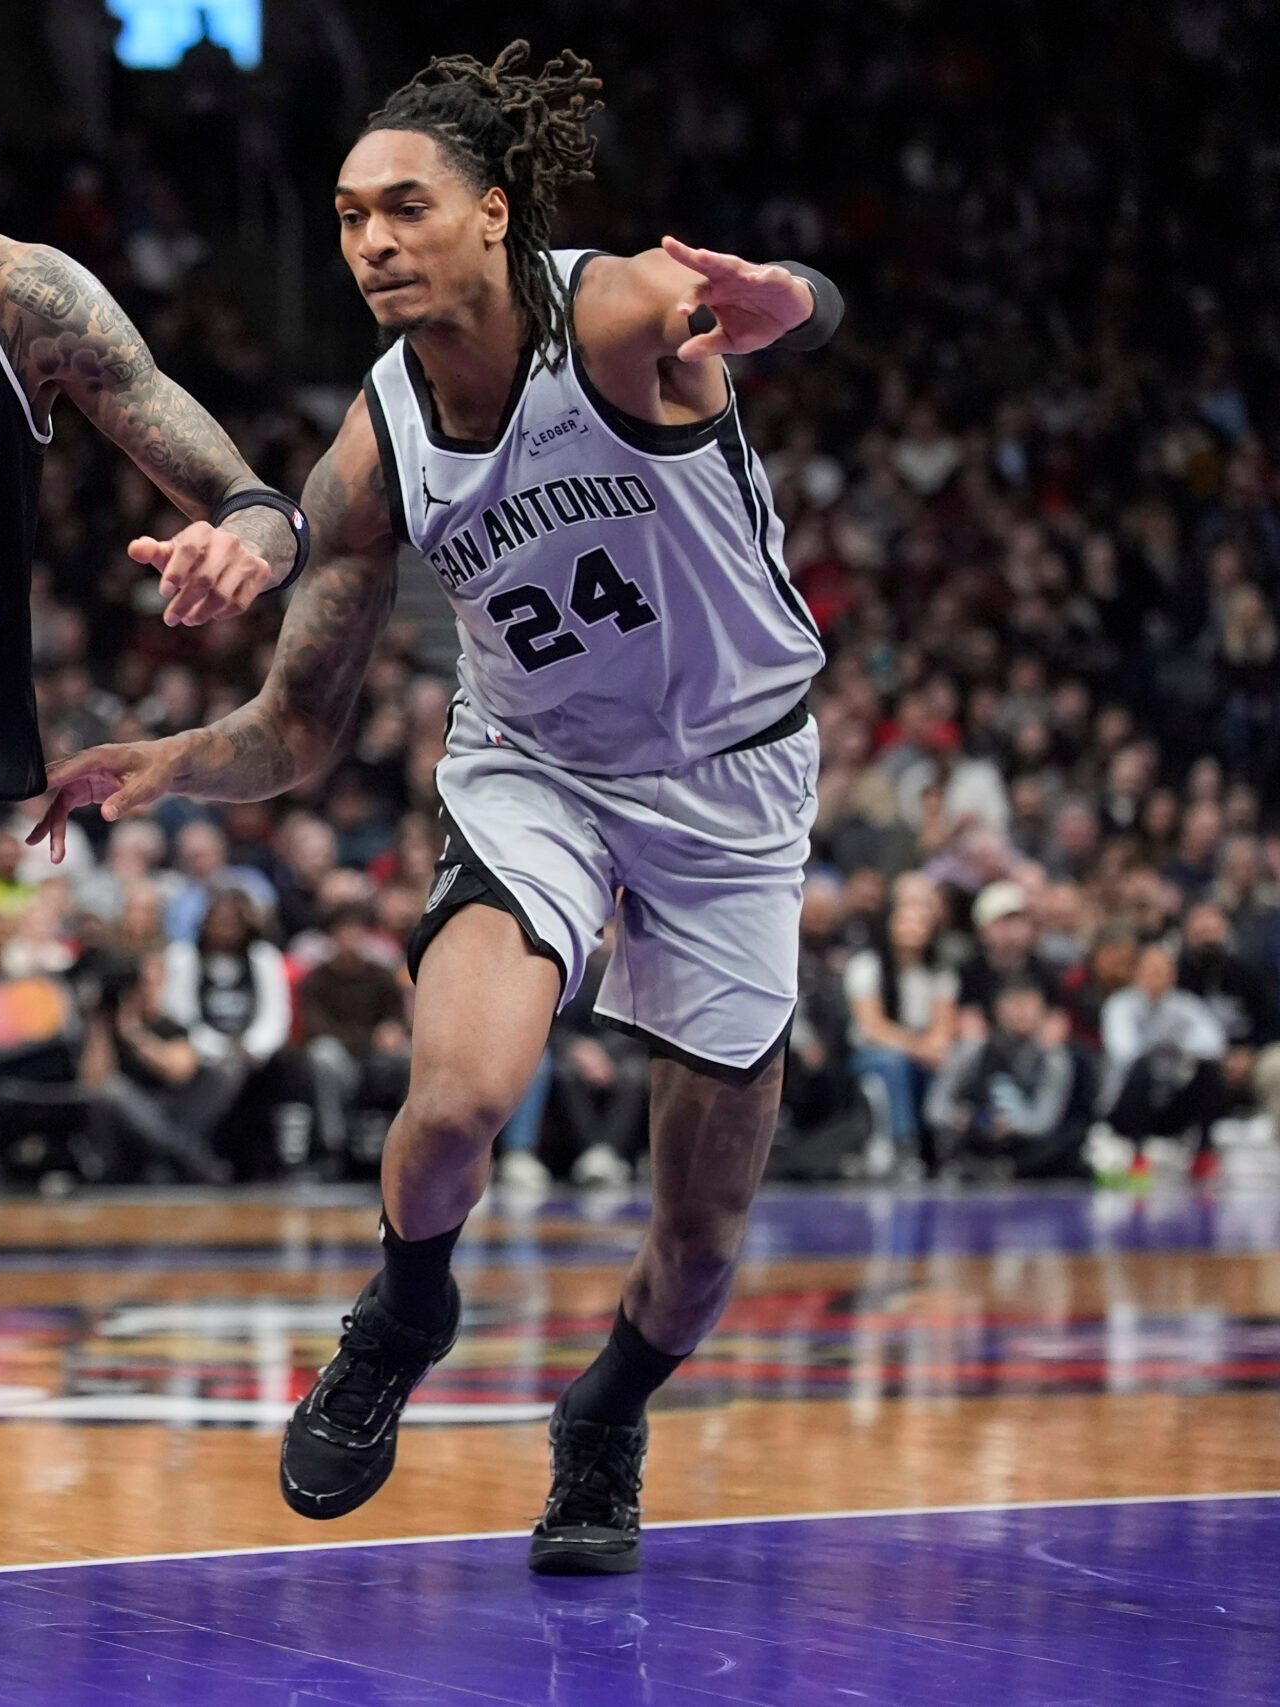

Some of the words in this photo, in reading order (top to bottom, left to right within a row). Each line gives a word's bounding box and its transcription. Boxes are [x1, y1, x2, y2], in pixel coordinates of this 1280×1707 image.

[531, 419, 577, 447] LEDGER
[428, 527, 489, 589] SAN
[481, 474, 656, 561] ANTONIO
[484, 545, 661, 674] 24
